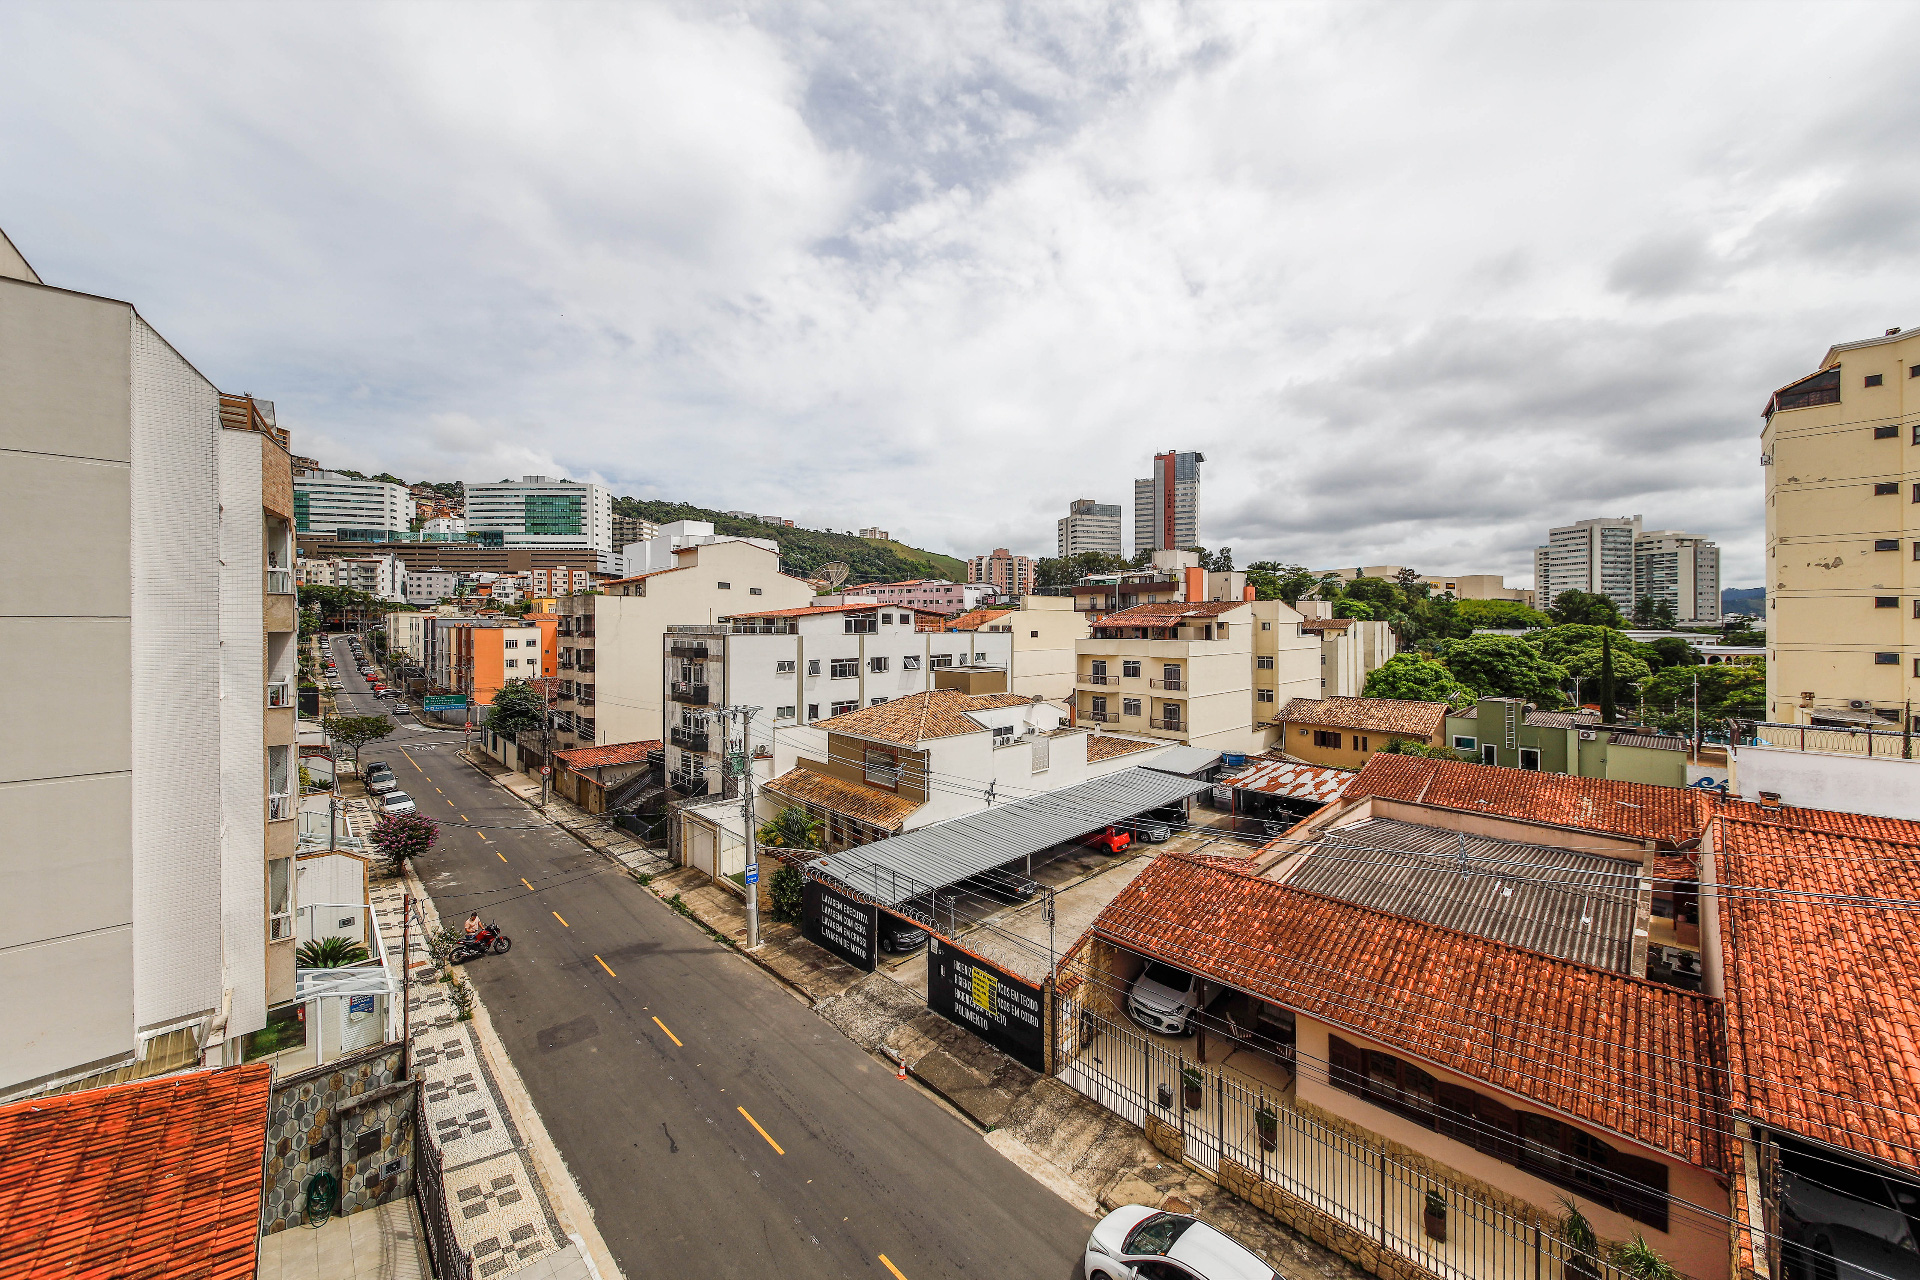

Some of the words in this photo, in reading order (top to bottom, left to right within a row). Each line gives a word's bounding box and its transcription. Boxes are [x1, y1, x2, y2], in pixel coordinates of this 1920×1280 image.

[822, 893, 842, 911] LAVAGEM
[844, 904, 868, 924] EXECUTIVA
[822, 904, 842, 922] LAVAGEM
[844, 916, 853, 928] COM
[822, 916, 842, 934] LAVAGEM
[822, 926, 842, 945] LAVAGEM
[1010, 988, 1019, 1003] EM
[1020, 994, 1039, 1012] TECIDO
[1011, 1004, 1020, 1018] EM
[954, 1002, 988, 1030] POLIMENTO
